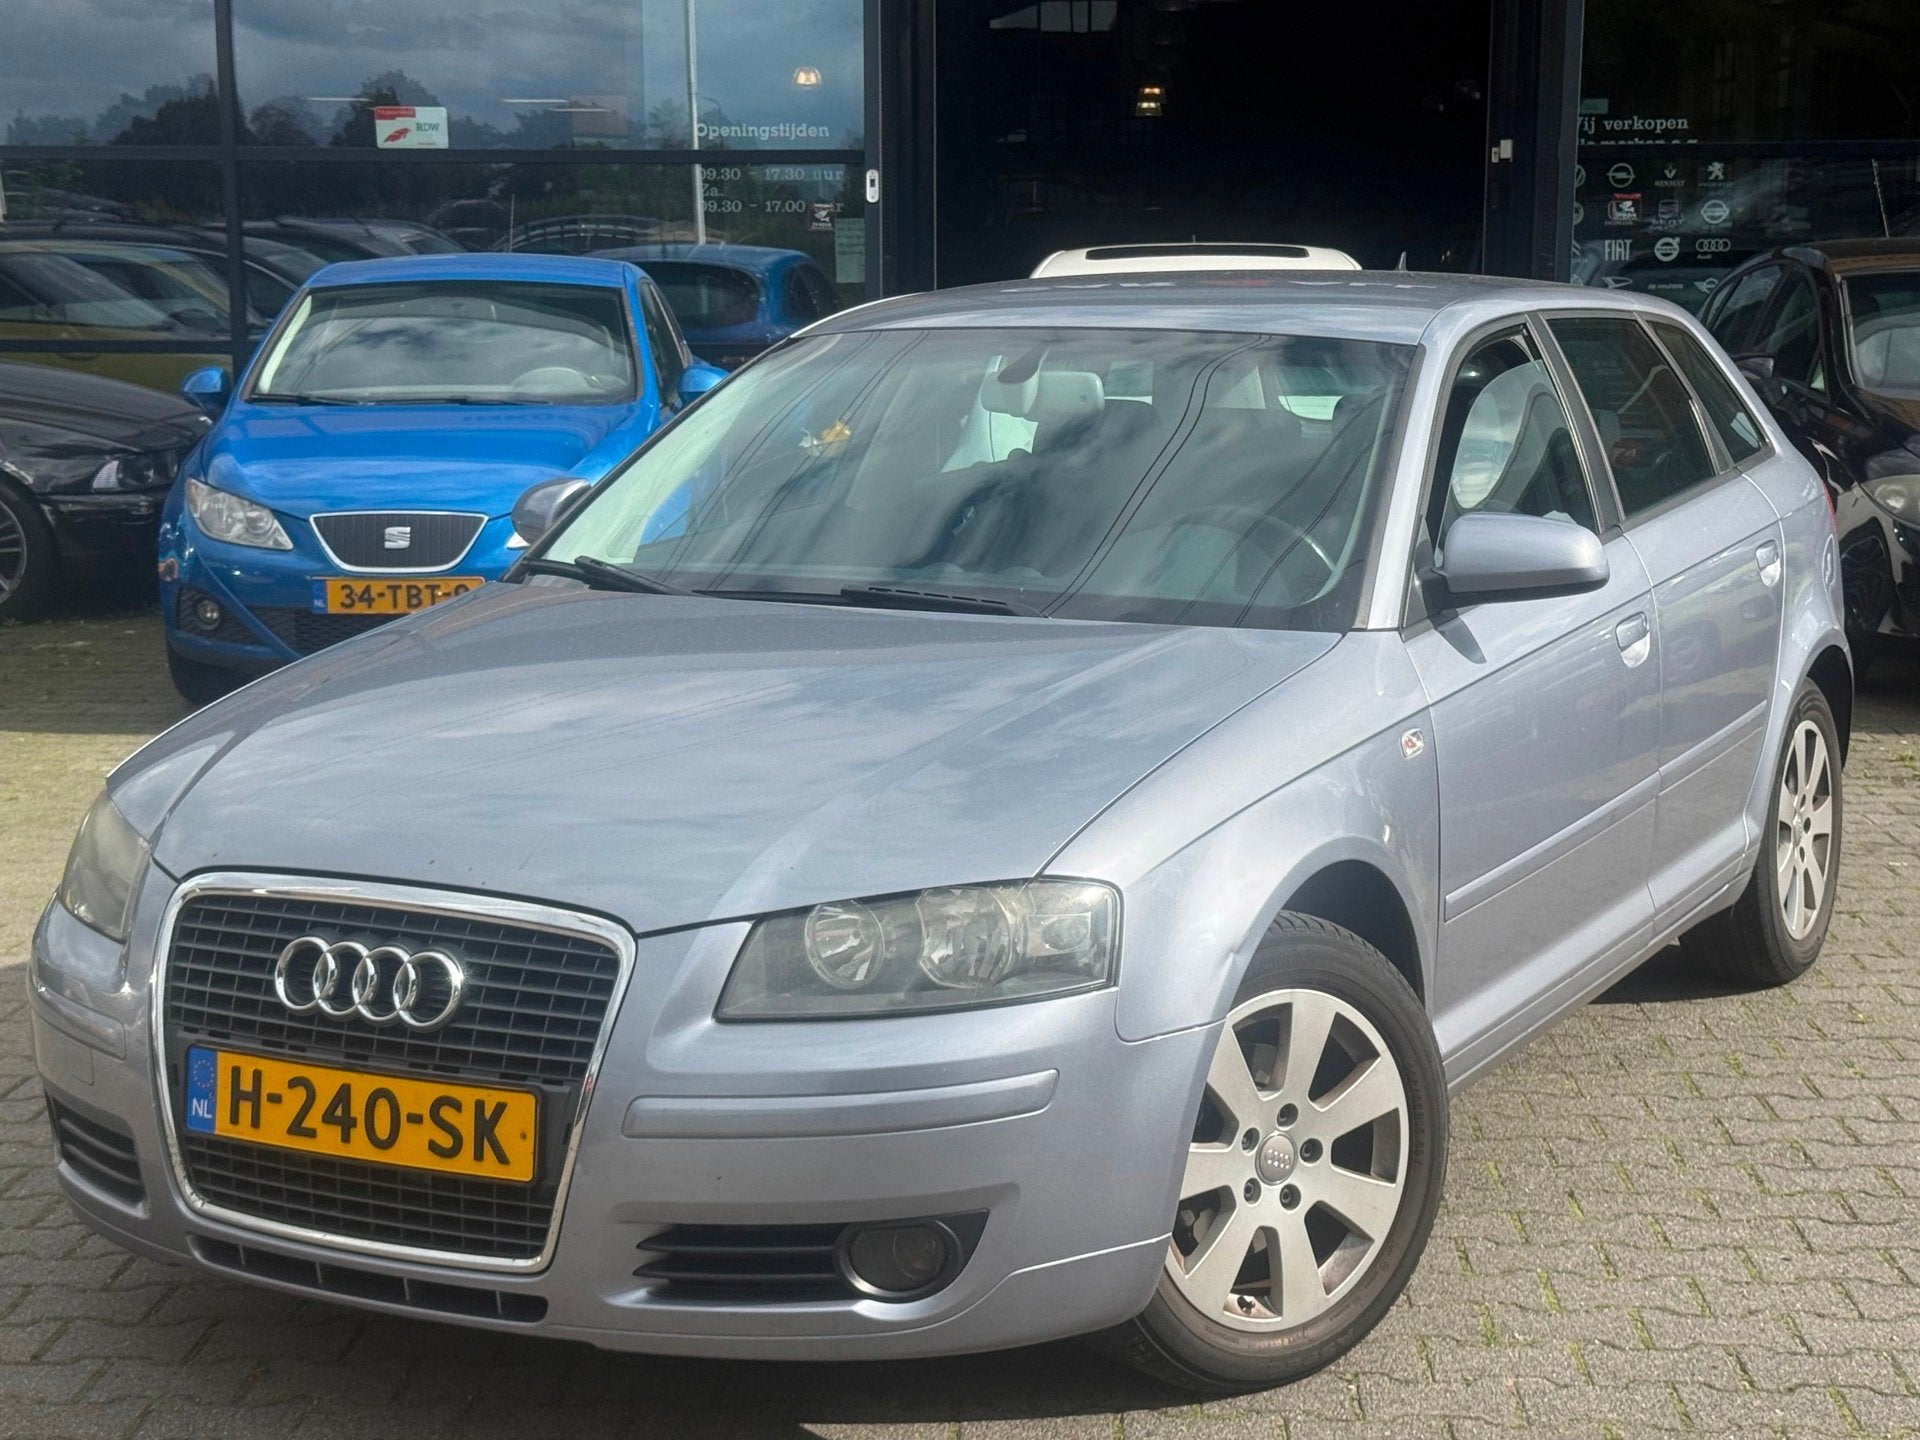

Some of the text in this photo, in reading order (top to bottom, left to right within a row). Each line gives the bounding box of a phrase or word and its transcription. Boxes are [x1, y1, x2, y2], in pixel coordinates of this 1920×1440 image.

[415, 122, 440, 132] RDW
[697, 123, 830, 140] Openingstijden
[1603, 116, 1689, 133] verkopen
[765, 168, 805, 181] 17.30
[812, 169, 845, 181] uur
[765, 200, 806, 213] 17.00
[1604, 239, 1633, 261] FIAT
[192, 1098, 212, 1120] NL
[229, 1065, 511, 1165] H-240-SK
